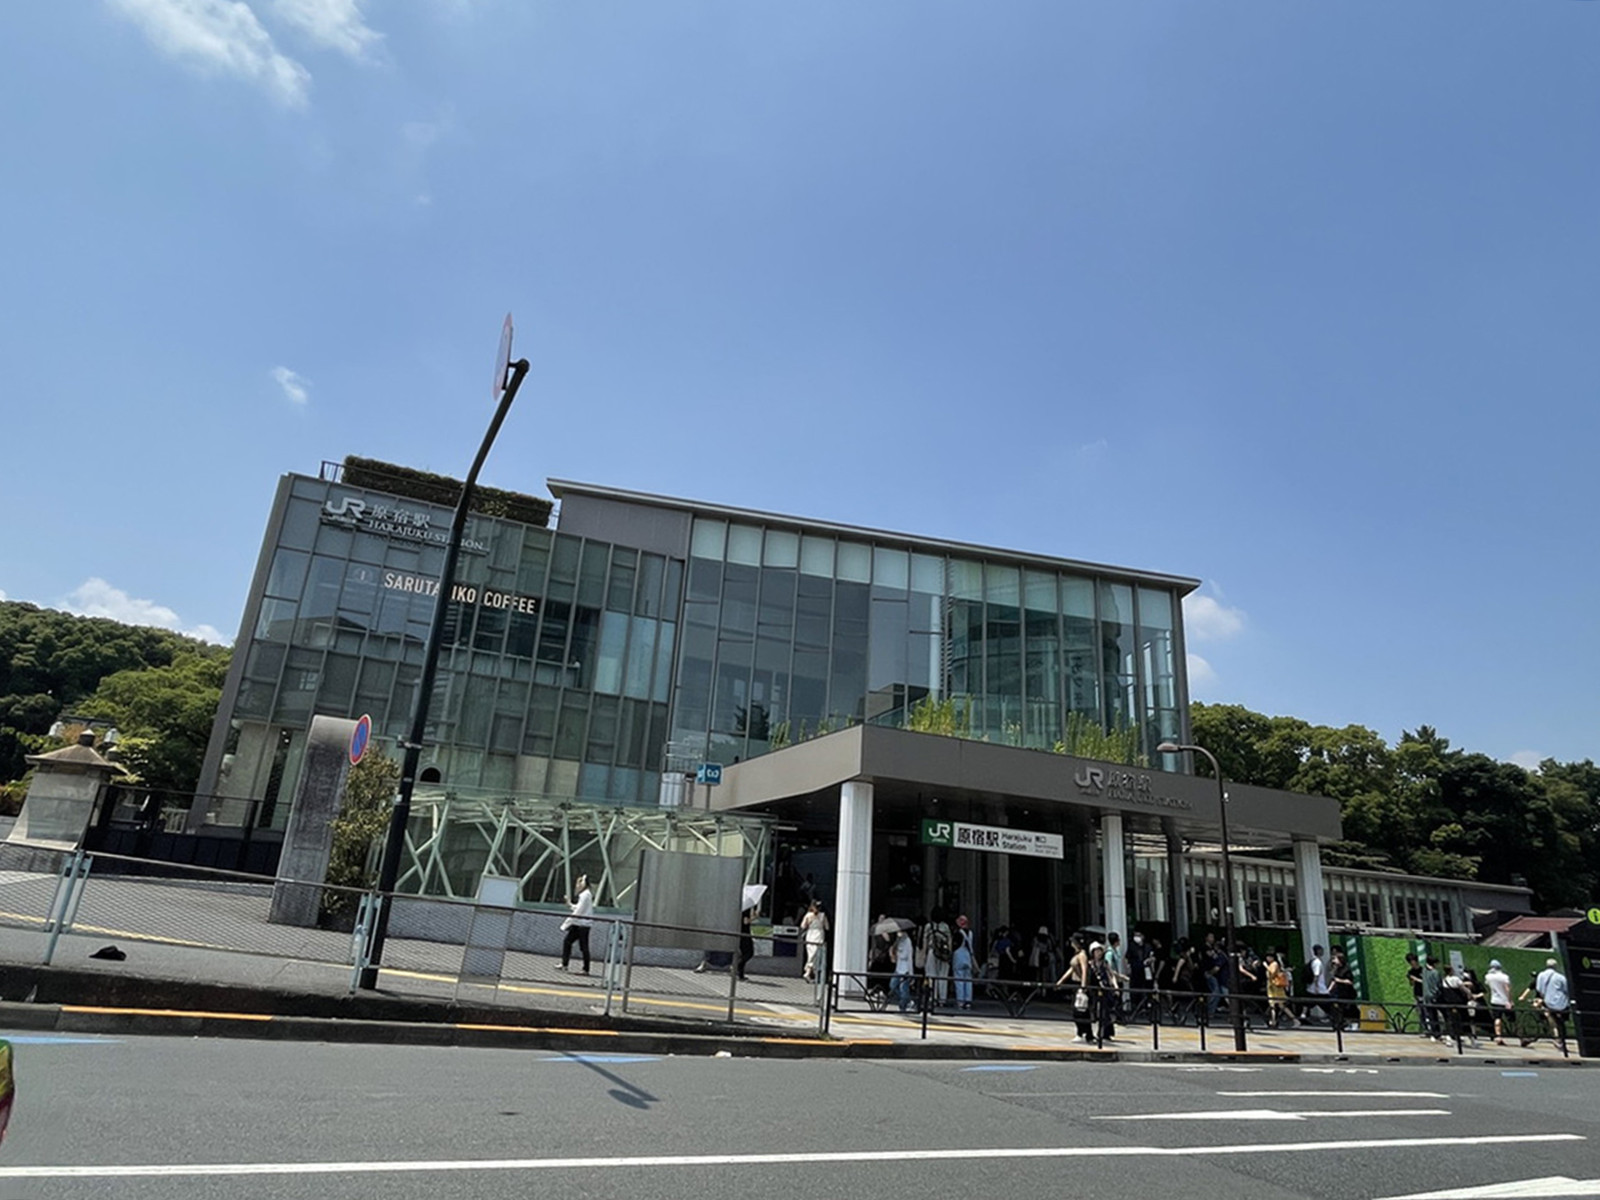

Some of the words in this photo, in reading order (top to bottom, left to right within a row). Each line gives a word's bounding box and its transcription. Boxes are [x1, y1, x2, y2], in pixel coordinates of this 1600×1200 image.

[326, 497, 366, 519] JR
[371, 504, 430, 528] 原宿駅
[368, 520, 432, 540] HARAJUKU
[434, 533, 484, 550] STION
[384, 573, 476, 603] SARUTAIKO
[483, 591, 536, 614] COFFEE
[1075, 767, 1104, 790] JR
[928, 823, 951, 839] JR
[957, 827, 999, 847] 原宿駅
[1001, 832, 1032, 844] Harajuku
[1002, 841, 1027, 851] Station
